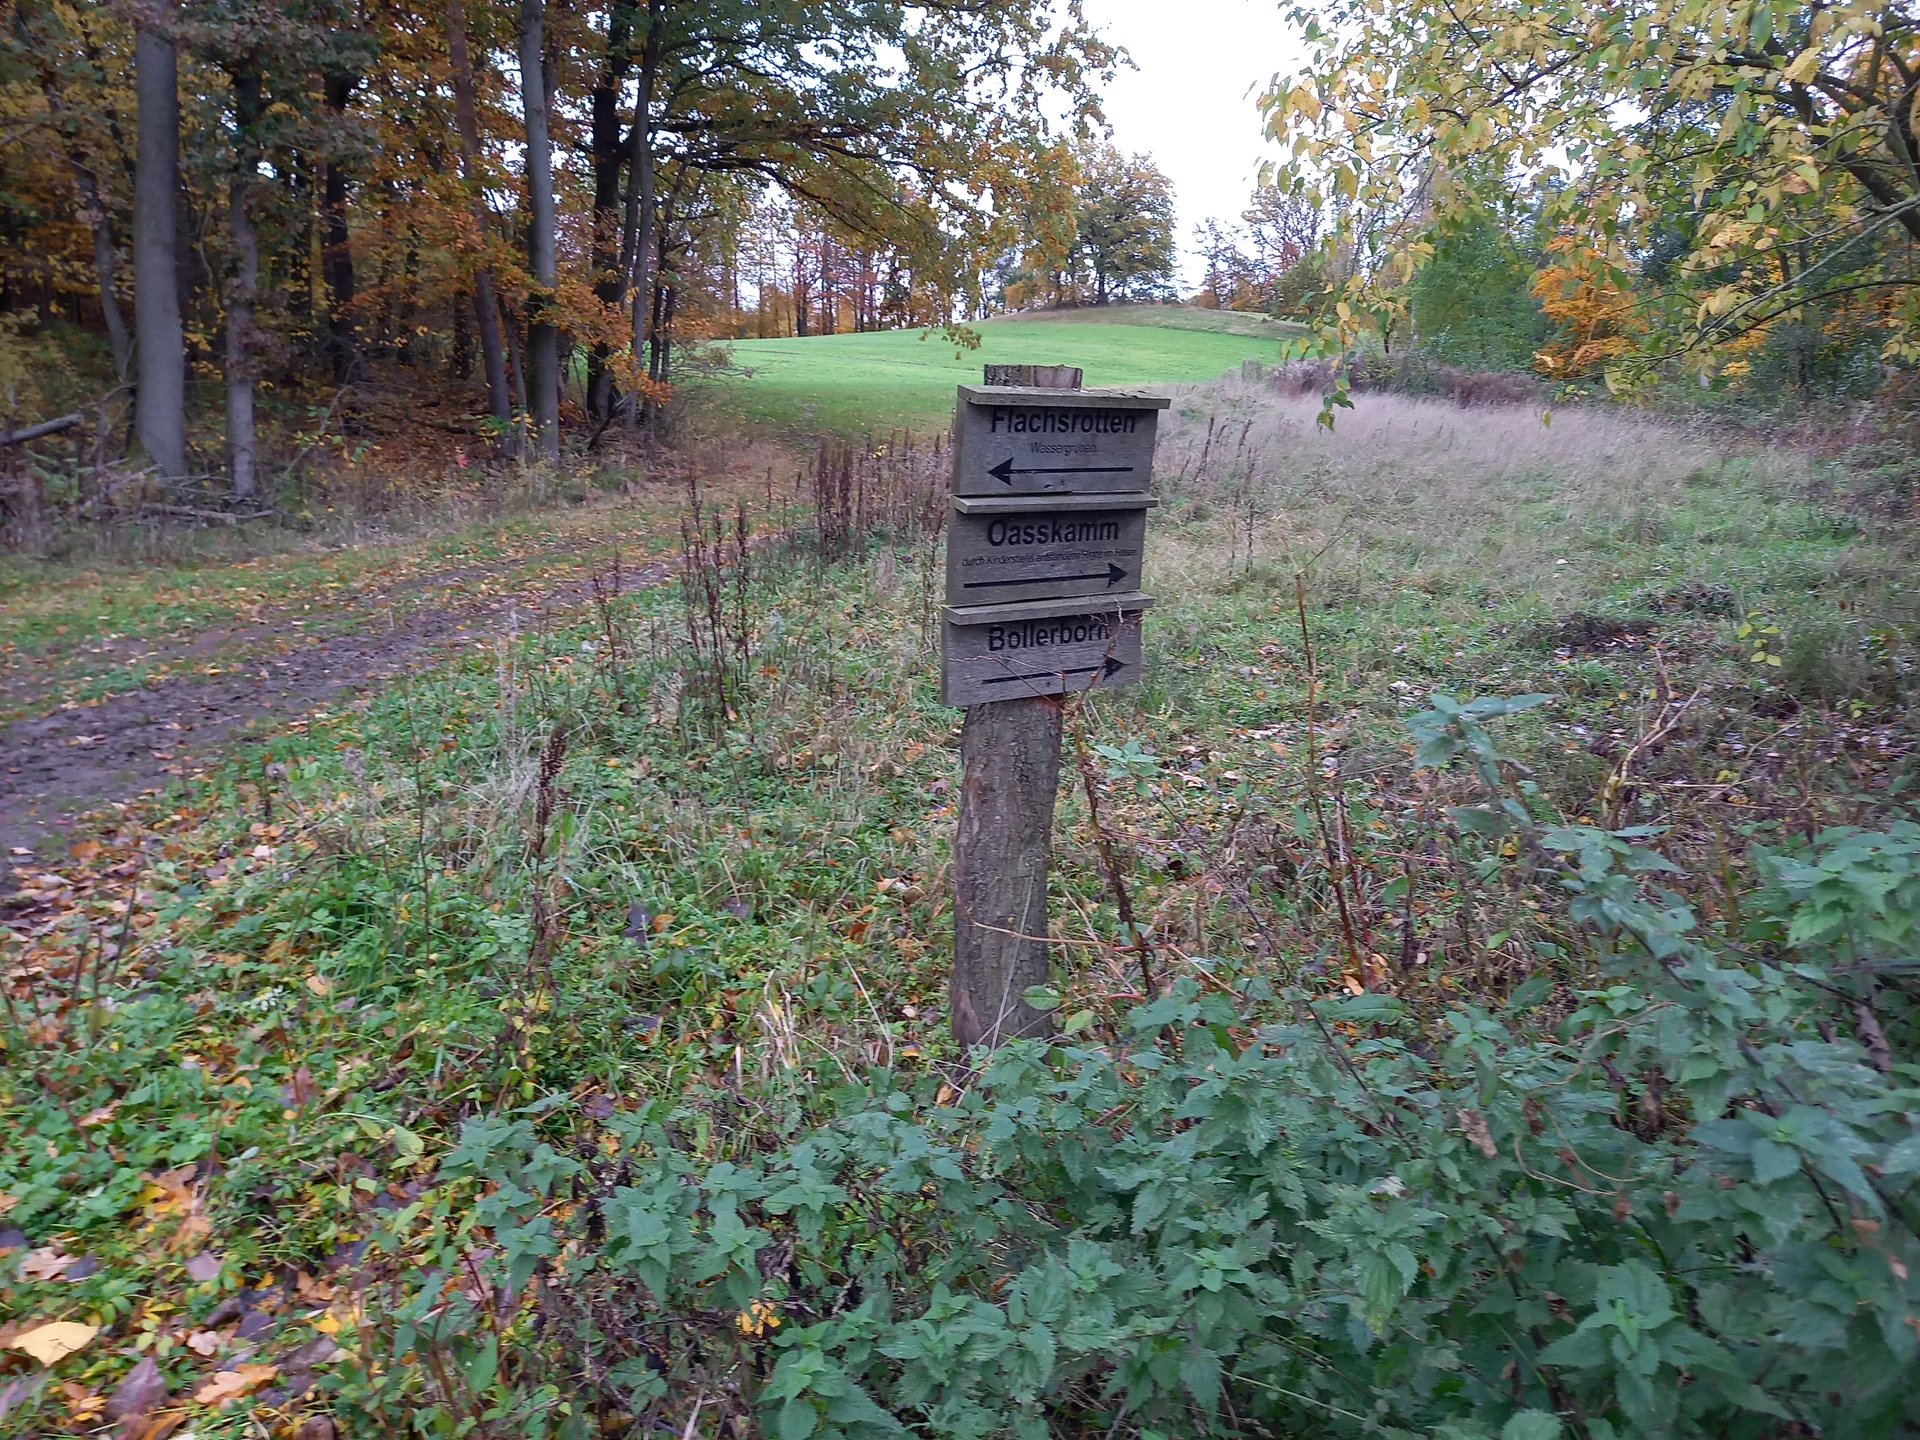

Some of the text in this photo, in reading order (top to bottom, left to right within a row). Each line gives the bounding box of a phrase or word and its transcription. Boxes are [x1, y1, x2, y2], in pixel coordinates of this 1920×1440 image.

[991, 406, 1136, 433] Flachsrotten
[988, 518, 1119, 547] Oasskamm
[988, 622, 1109, 651] Bollerborn
